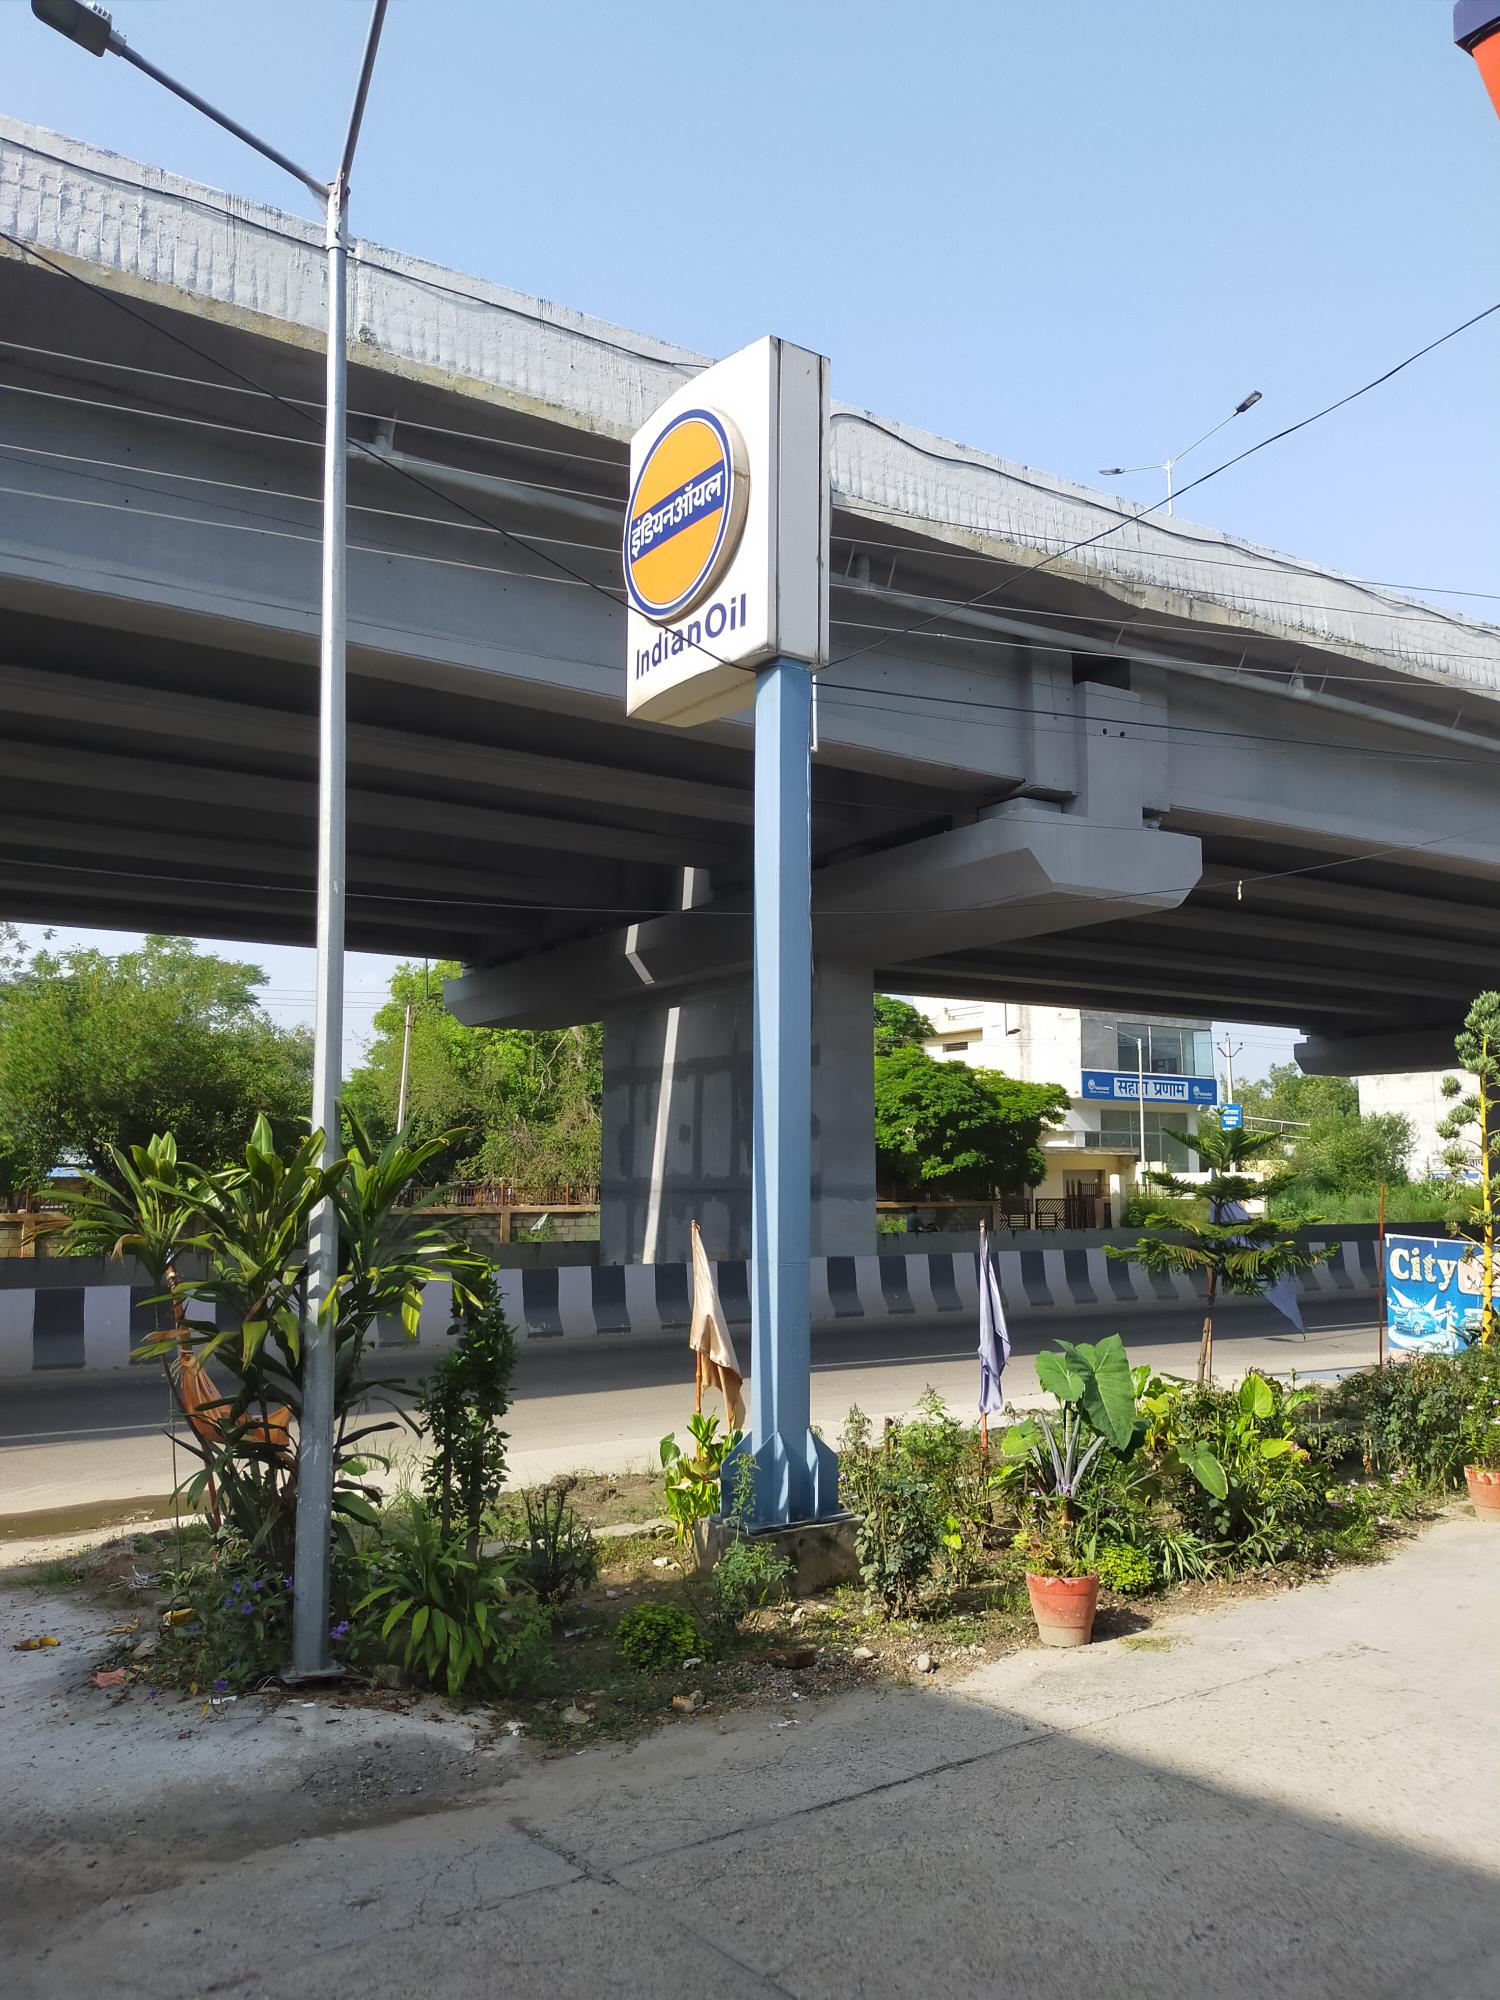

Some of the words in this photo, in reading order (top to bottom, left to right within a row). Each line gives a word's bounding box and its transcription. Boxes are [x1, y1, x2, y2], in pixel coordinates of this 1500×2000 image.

[631, 471, 724, 558] इंडियनऑयल
[635, 593, 747, 681] IndianOil
[1153, 1082, 1186, 1098] प्रणाम
[1389, 1247, 1458, 1292] City
